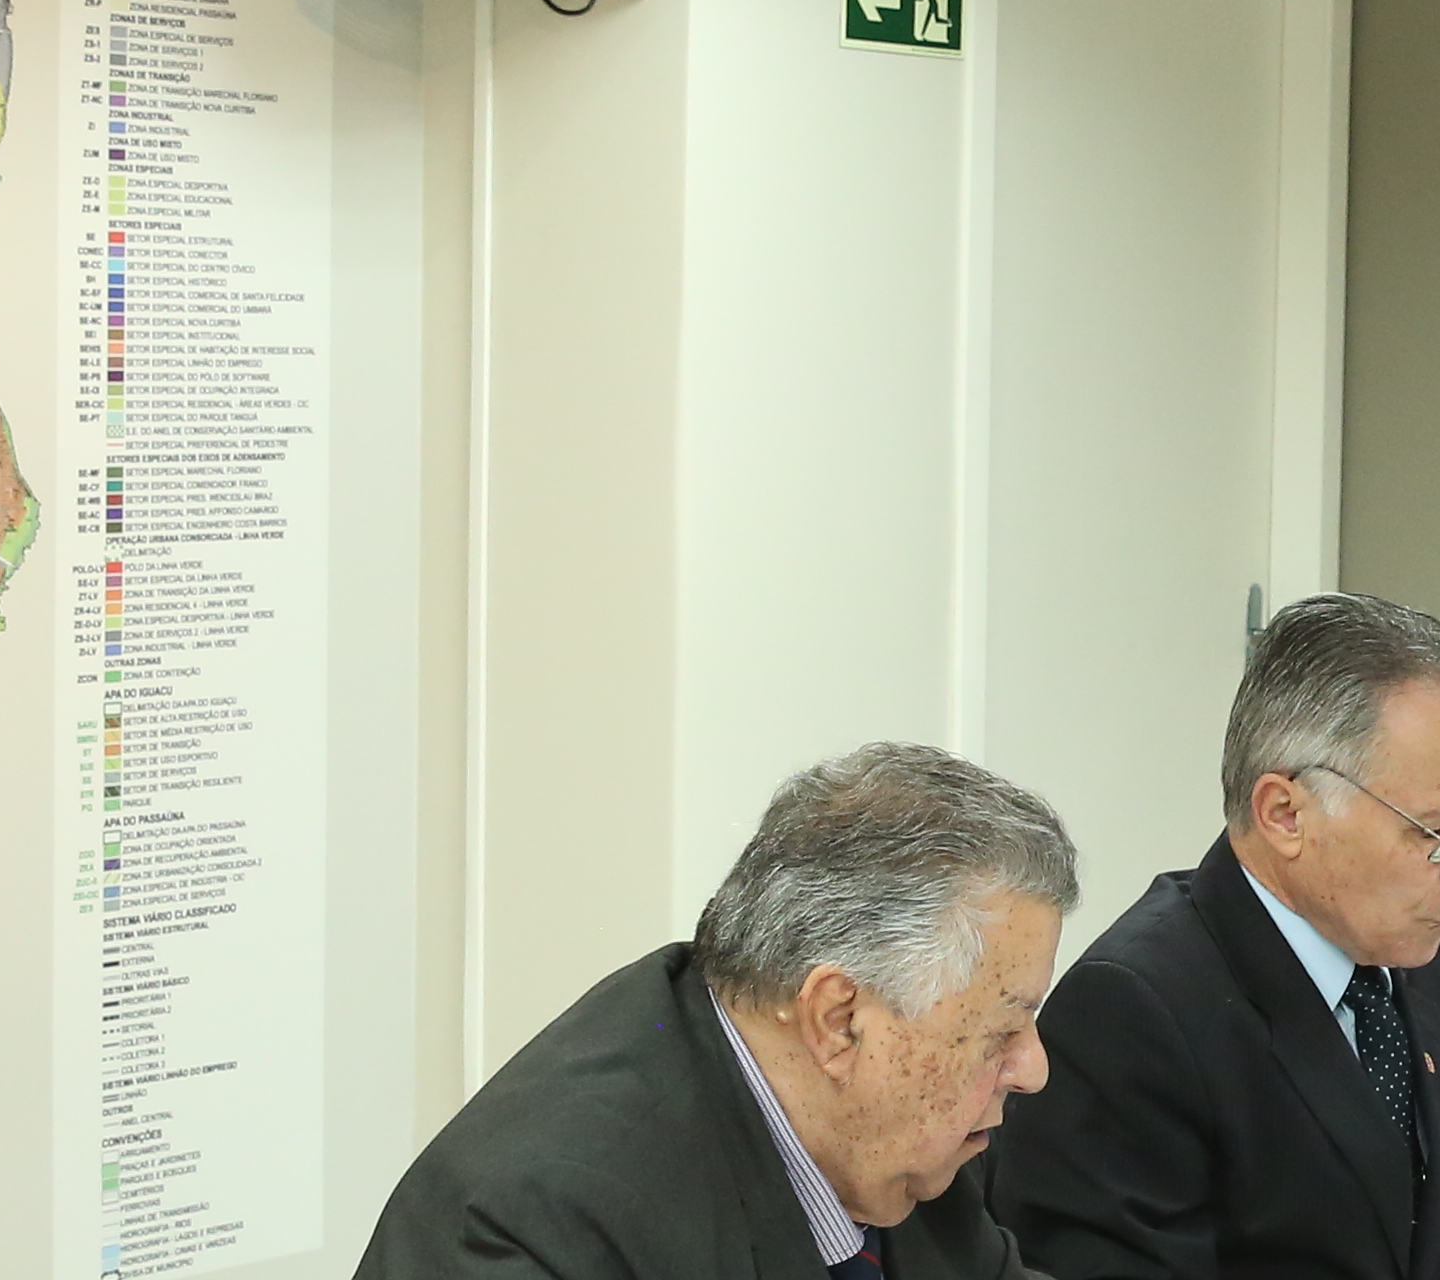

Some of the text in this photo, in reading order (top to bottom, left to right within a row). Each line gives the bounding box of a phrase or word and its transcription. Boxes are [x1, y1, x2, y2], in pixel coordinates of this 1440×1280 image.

[105, 689, 121, 700] APA
[124, 688, 136, 699] DO
[104, 817, 120, 828] APA
[123, 816, 135, 826] DO
[104, 914, 141, 928] SISTEMA
[175, 903, 237, 920] CLASSIFICADO
